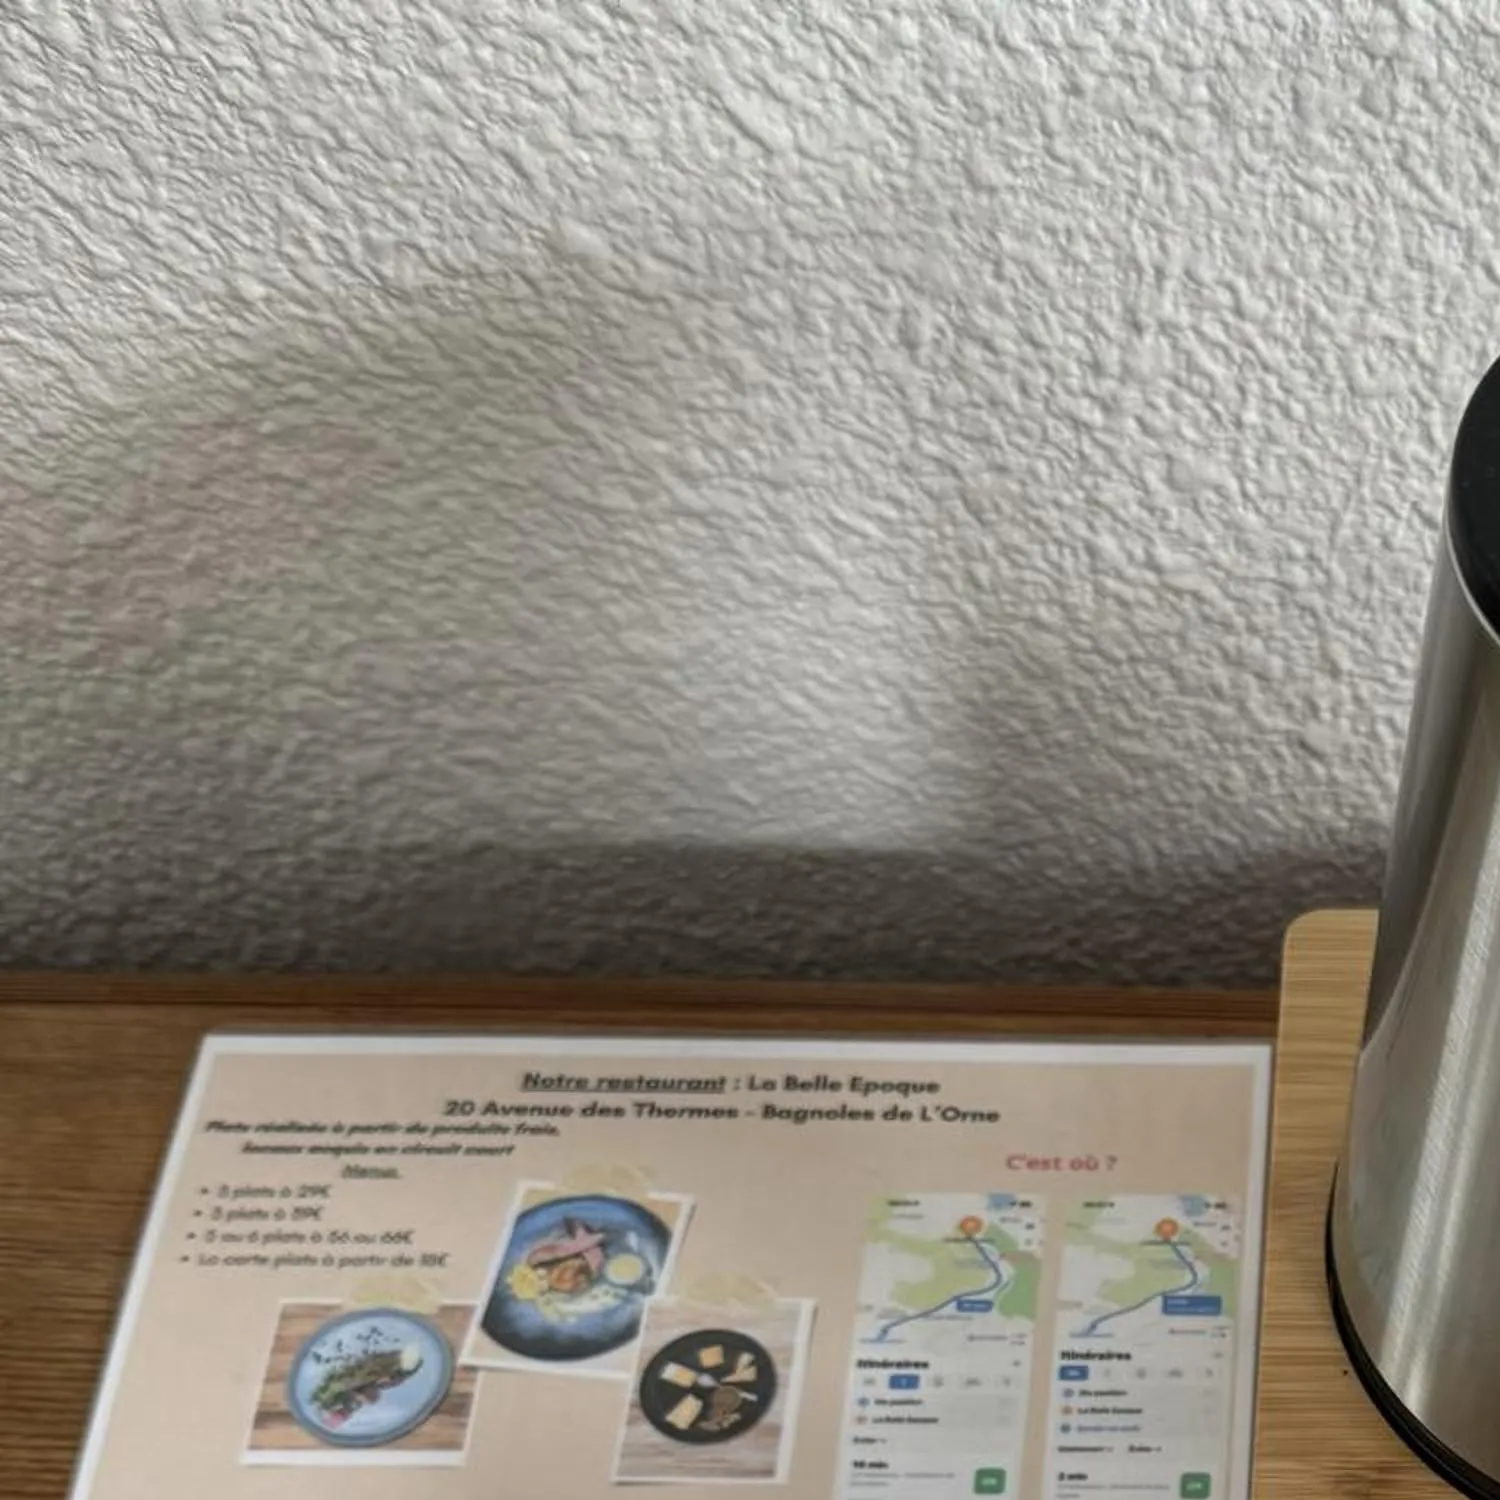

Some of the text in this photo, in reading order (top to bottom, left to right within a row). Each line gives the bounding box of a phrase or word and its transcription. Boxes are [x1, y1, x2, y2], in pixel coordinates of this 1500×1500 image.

[522, 1072, 590, 1092] Notre
[597, 1074, 726, 1093] restaurant
[747, 1075, 777, 1091] La
[783, 1075, 842, 1092] Belle
[445, 1100, 1001, 1124] 20 Avenue des Thermes Bagnoles de L'Orne
[1005, 1154, 1061, 1171] C'est
[1069, 1154, 1099, 1171] où
